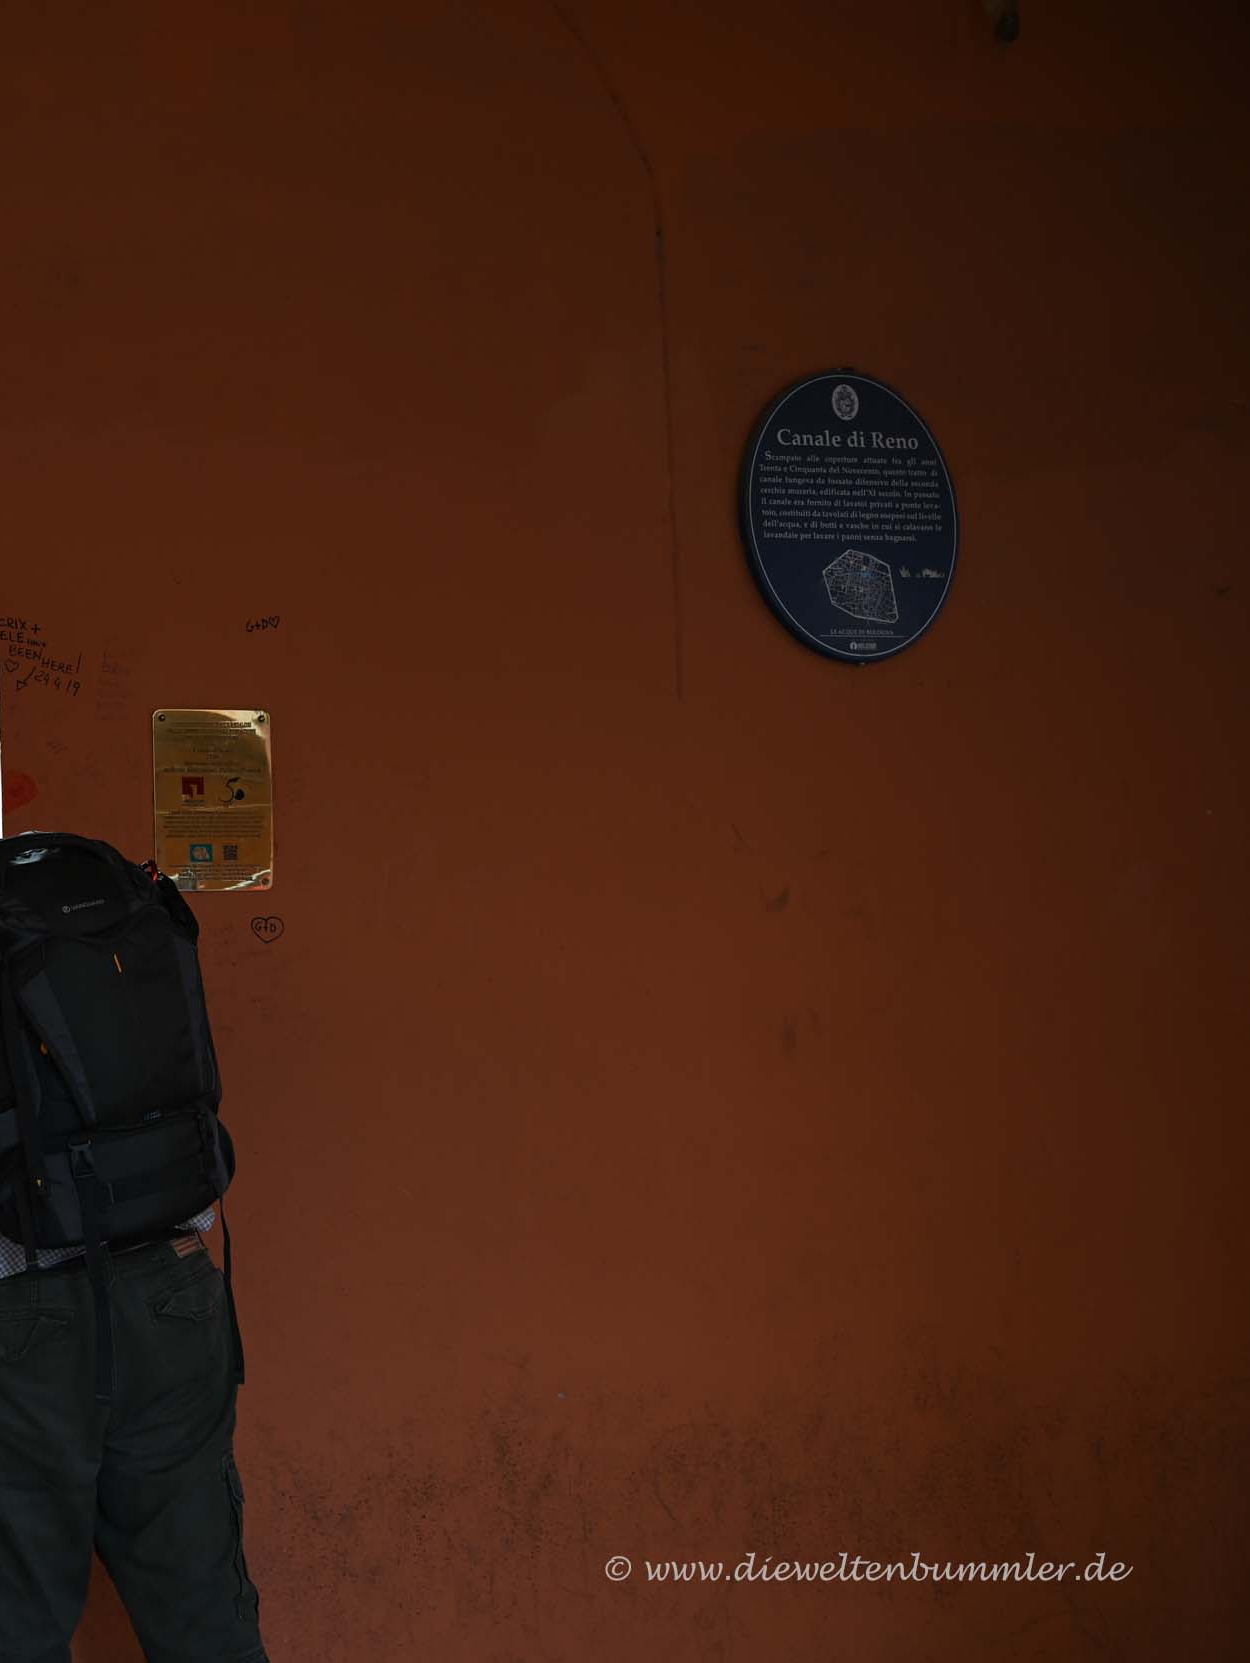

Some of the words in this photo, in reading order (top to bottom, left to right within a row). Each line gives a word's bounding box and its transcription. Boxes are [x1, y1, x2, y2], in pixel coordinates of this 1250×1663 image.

[776, 428, 841, 448] Canale
[846, 430, 866, 448] di
[871, 431, 919, 450] Reno
